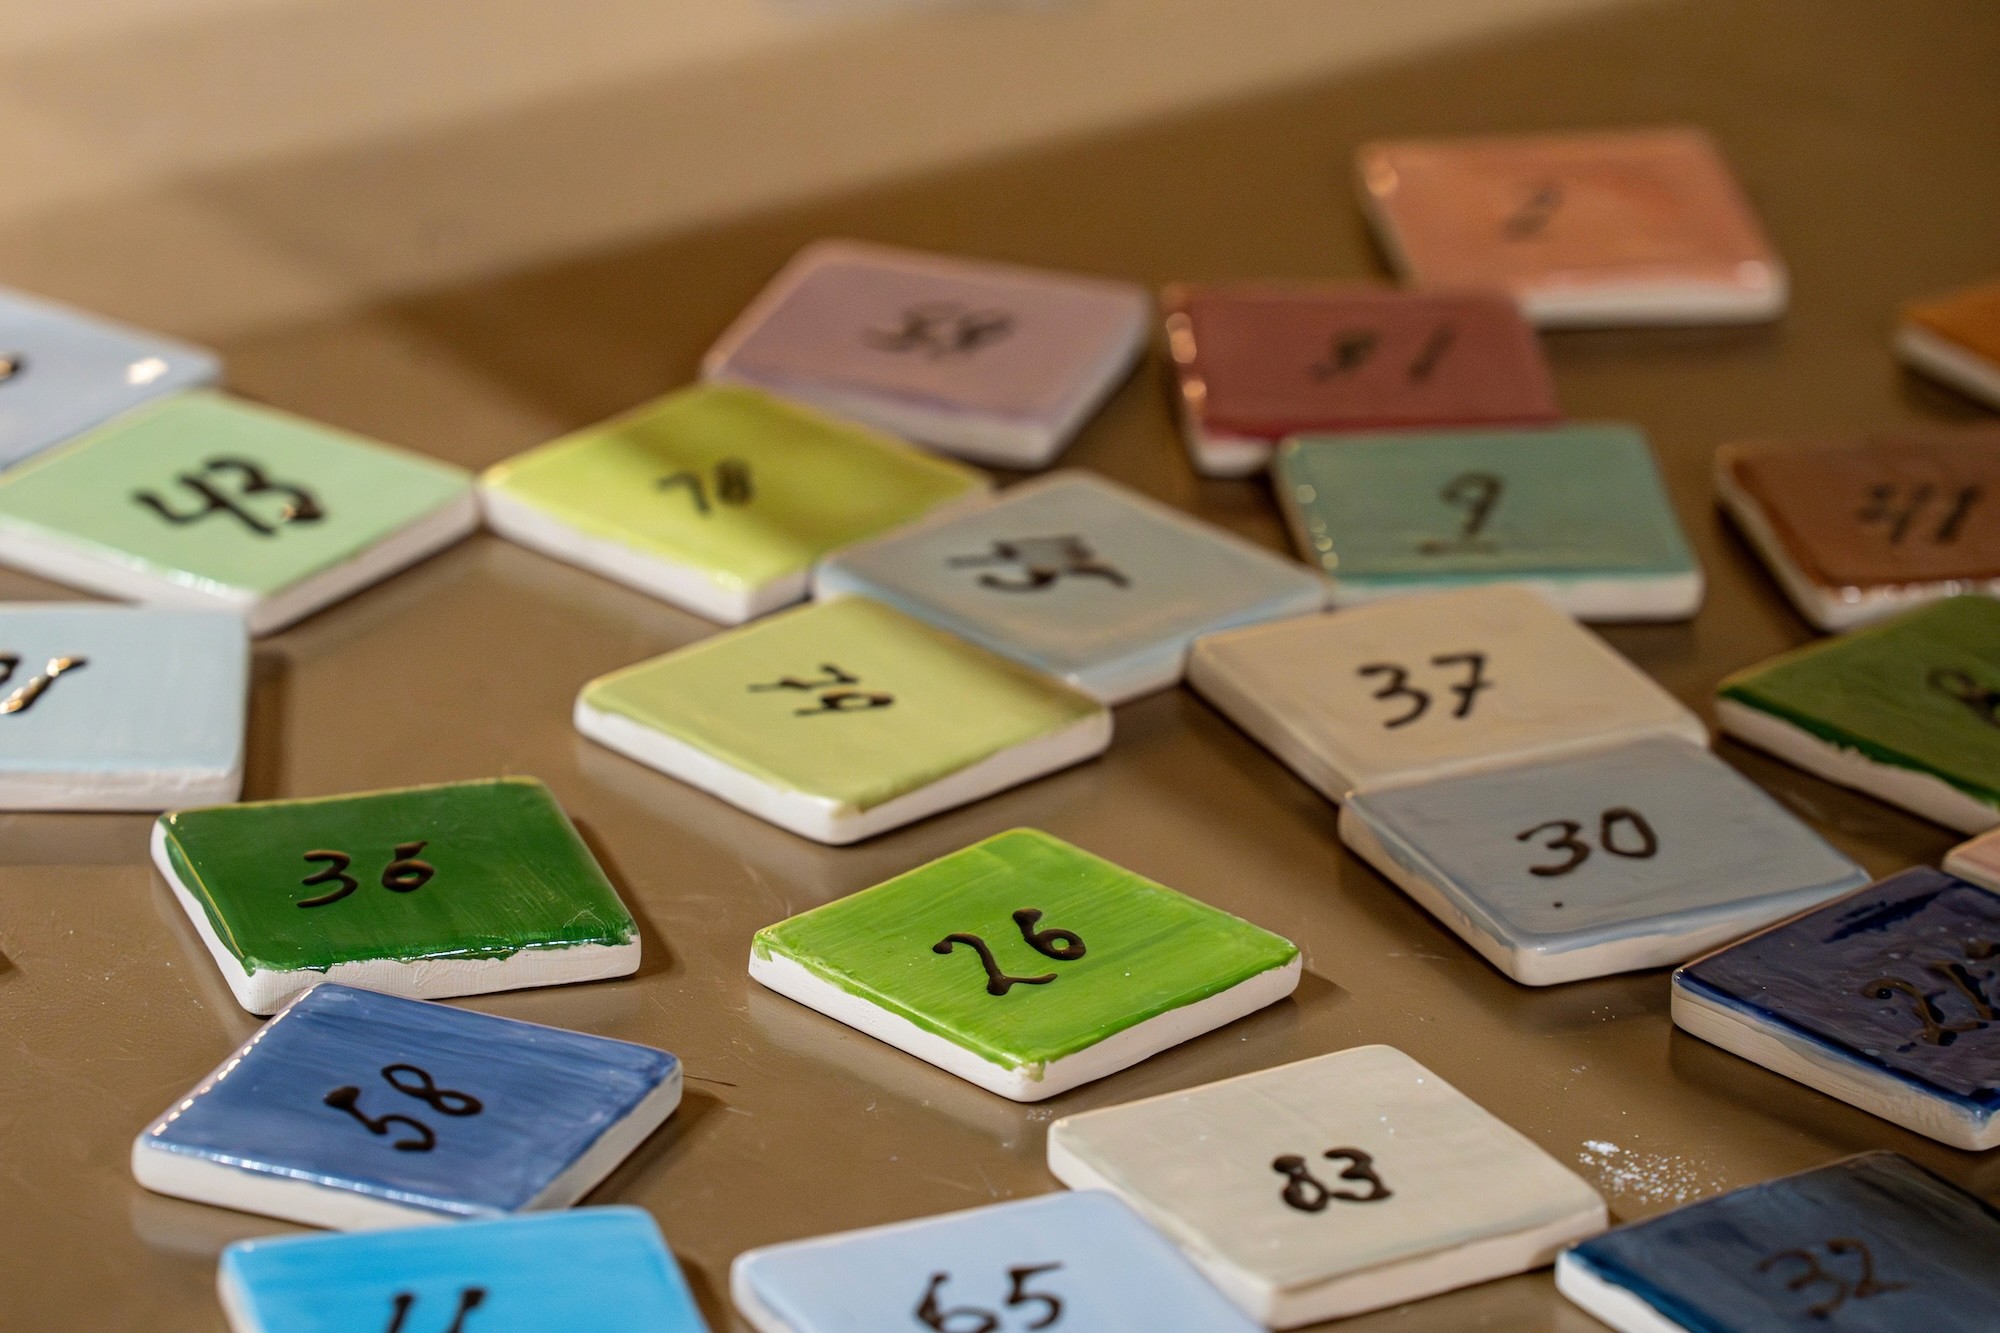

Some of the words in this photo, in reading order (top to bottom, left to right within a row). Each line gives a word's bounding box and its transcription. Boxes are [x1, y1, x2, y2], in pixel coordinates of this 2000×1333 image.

[131, 455, 326, 537] 43
[1356, 651, 1494, 729] 37
[297, 841, 434, 908] 36
[1516, 807, 1658, 877] 30
[933, 908, 1087, 995] 26
[323, 1063, 483, 1152] 58
[1272, 1147, 1393, 1213] 83
[917, 1262, 1065, 1333] 65
[1756, 1237, 1912, 1318] 32
